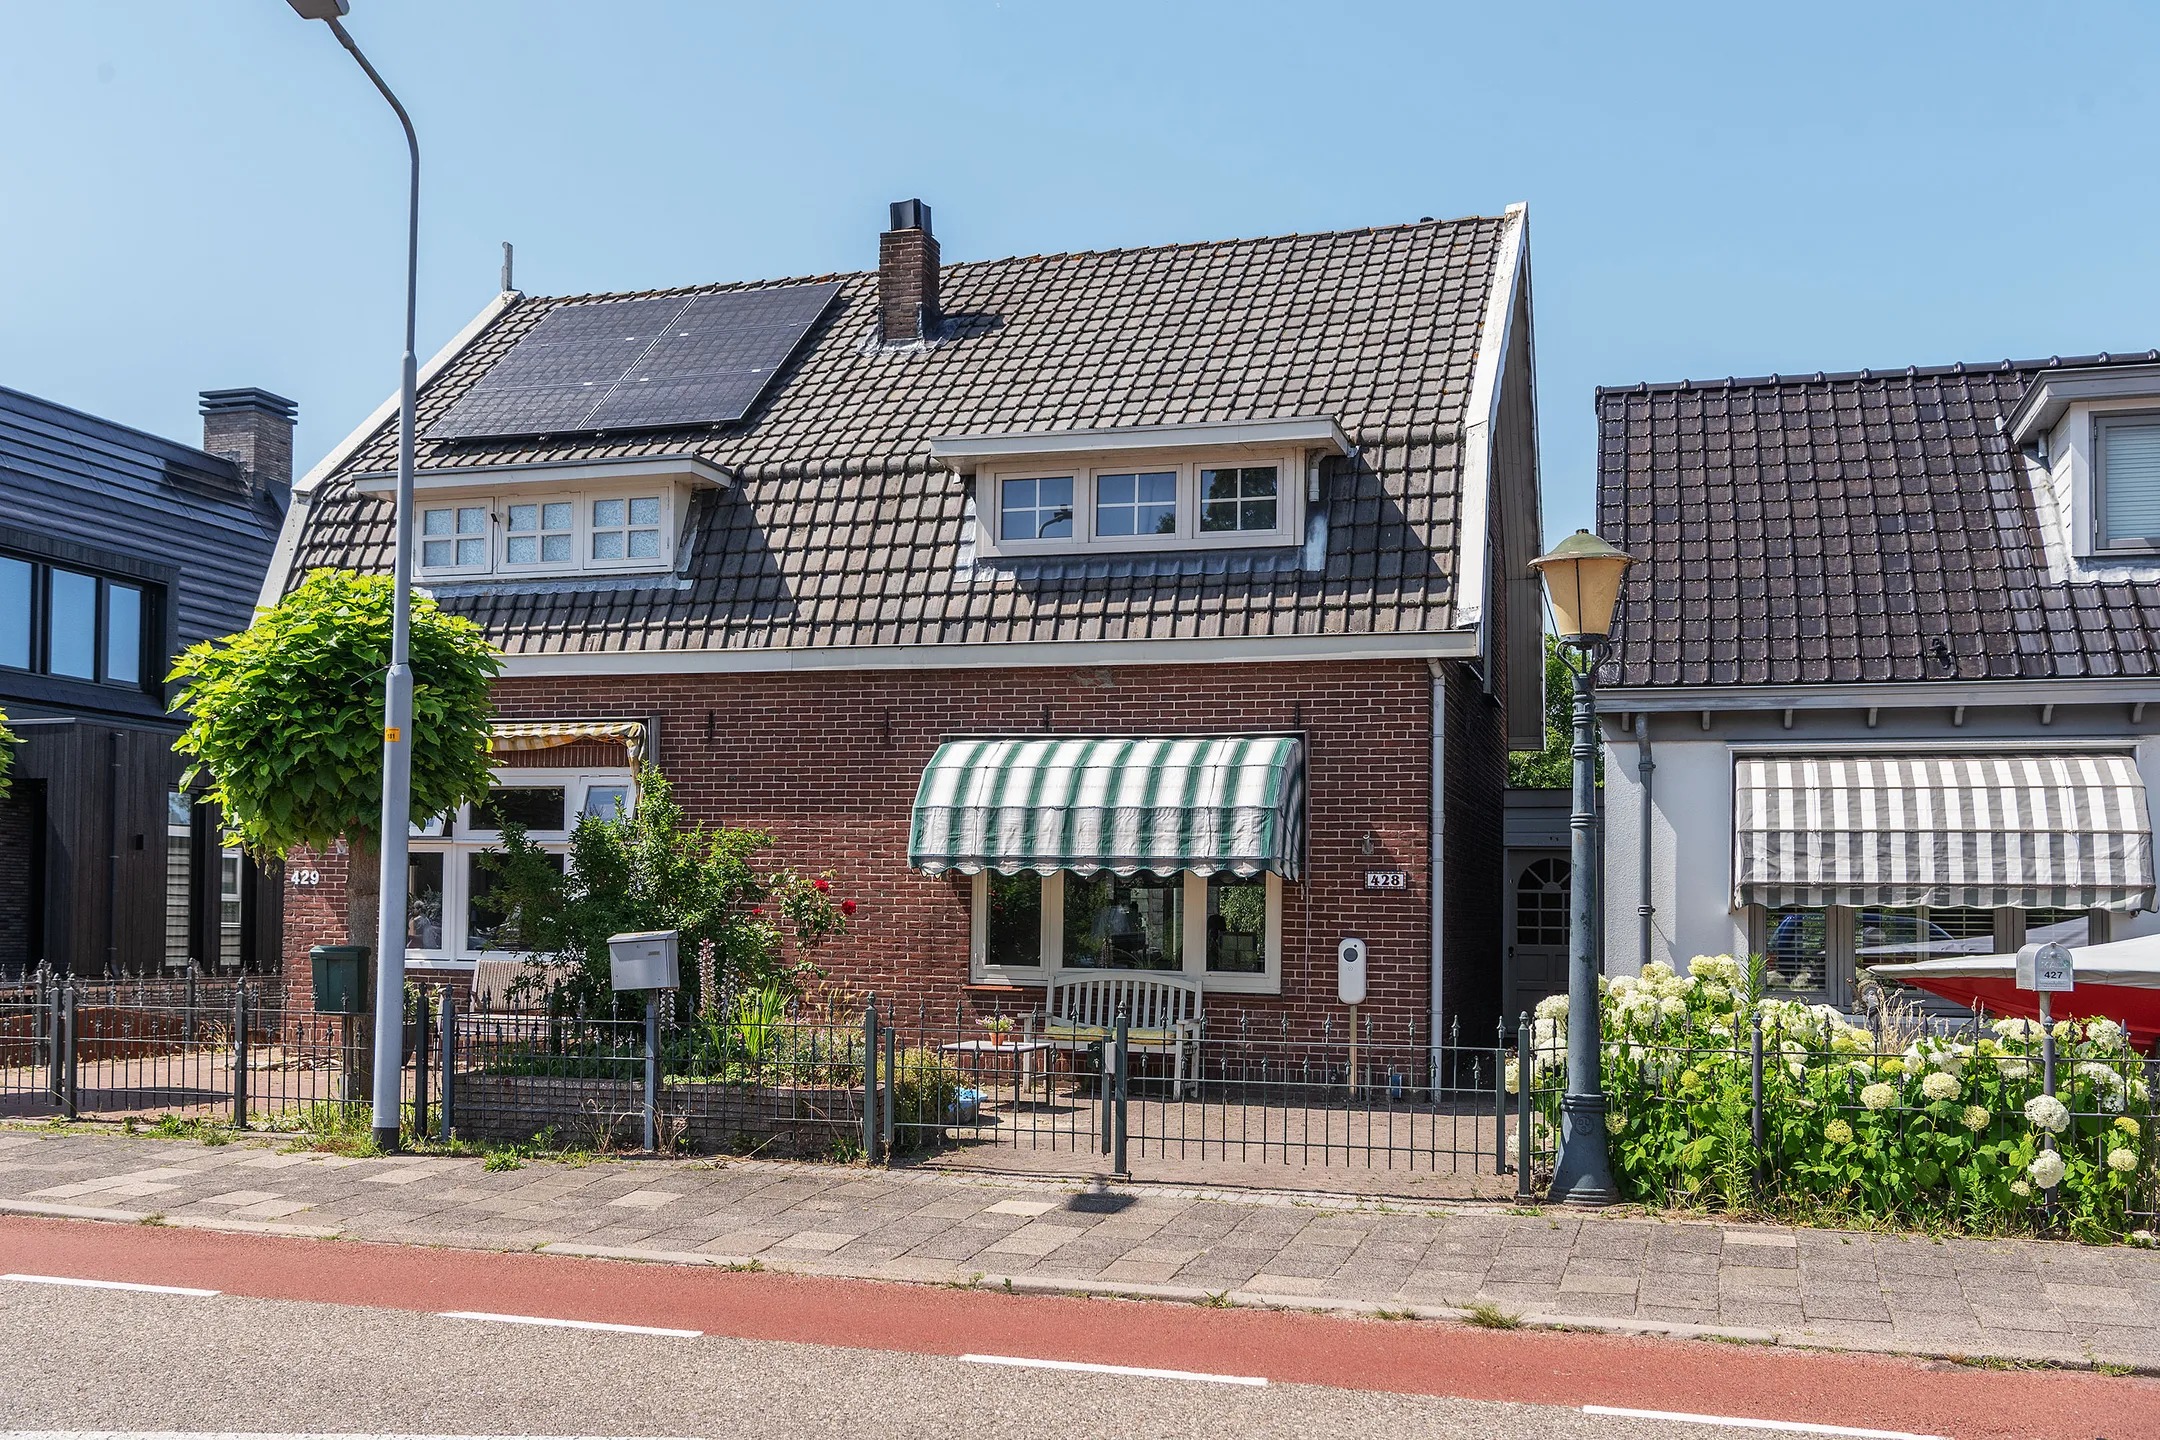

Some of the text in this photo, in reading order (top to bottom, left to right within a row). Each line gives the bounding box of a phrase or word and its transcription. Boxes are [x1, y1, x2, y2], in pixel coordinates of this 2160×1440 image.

[291, 869, 320, 885] 429
[1370, 874, 1400, 886] 428
[2044, 971, 2063, 979] 427
